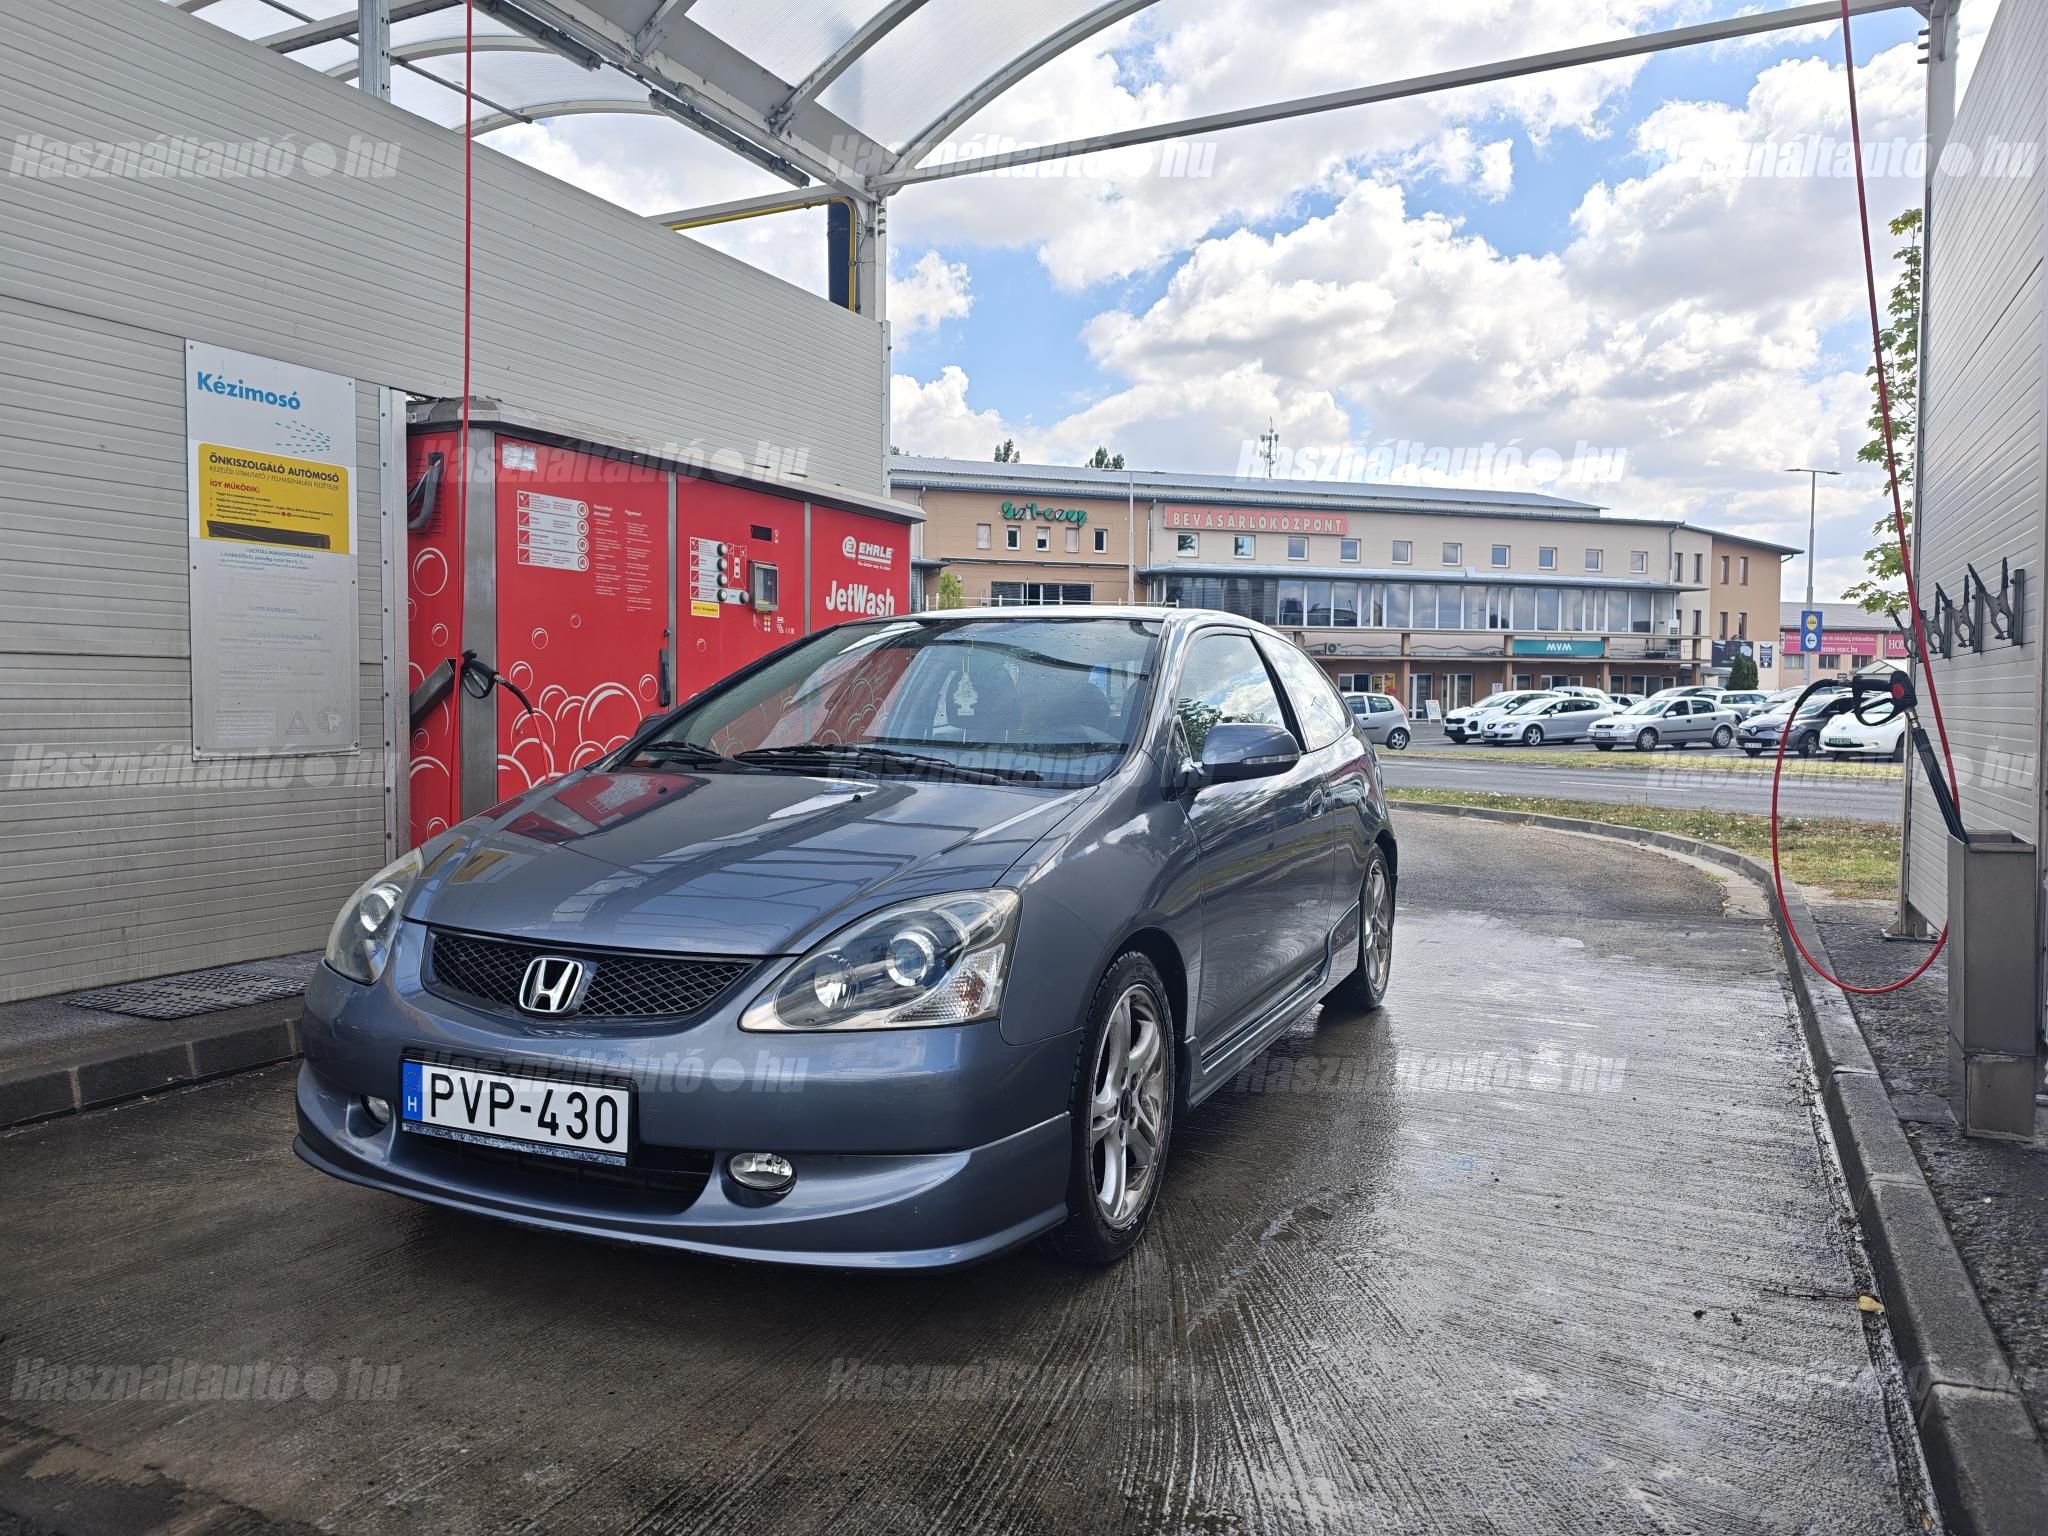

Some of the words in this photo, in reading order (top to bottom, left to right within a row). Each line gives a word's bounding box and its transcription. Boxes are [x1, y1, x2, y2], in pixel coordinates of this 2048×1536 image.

[197, 371, 301, 410] Kézimosó
[209, 452, 285, 474] ÖNKISZOLGÁLÓ
[288, 467, 339, 482] AUTÓMOSÓ
[1173, 508, 1343, 533] BEVÁSÁRLÓKÖZPONT
[859, 541, 893, 559] EHRLE
[826, 580, 895, 617] JetWash
[1546, 642, 1572, 652] MVM
[407, 1095, 417, 1112] H
[431, 1073, 618, 1143] PVP-430
